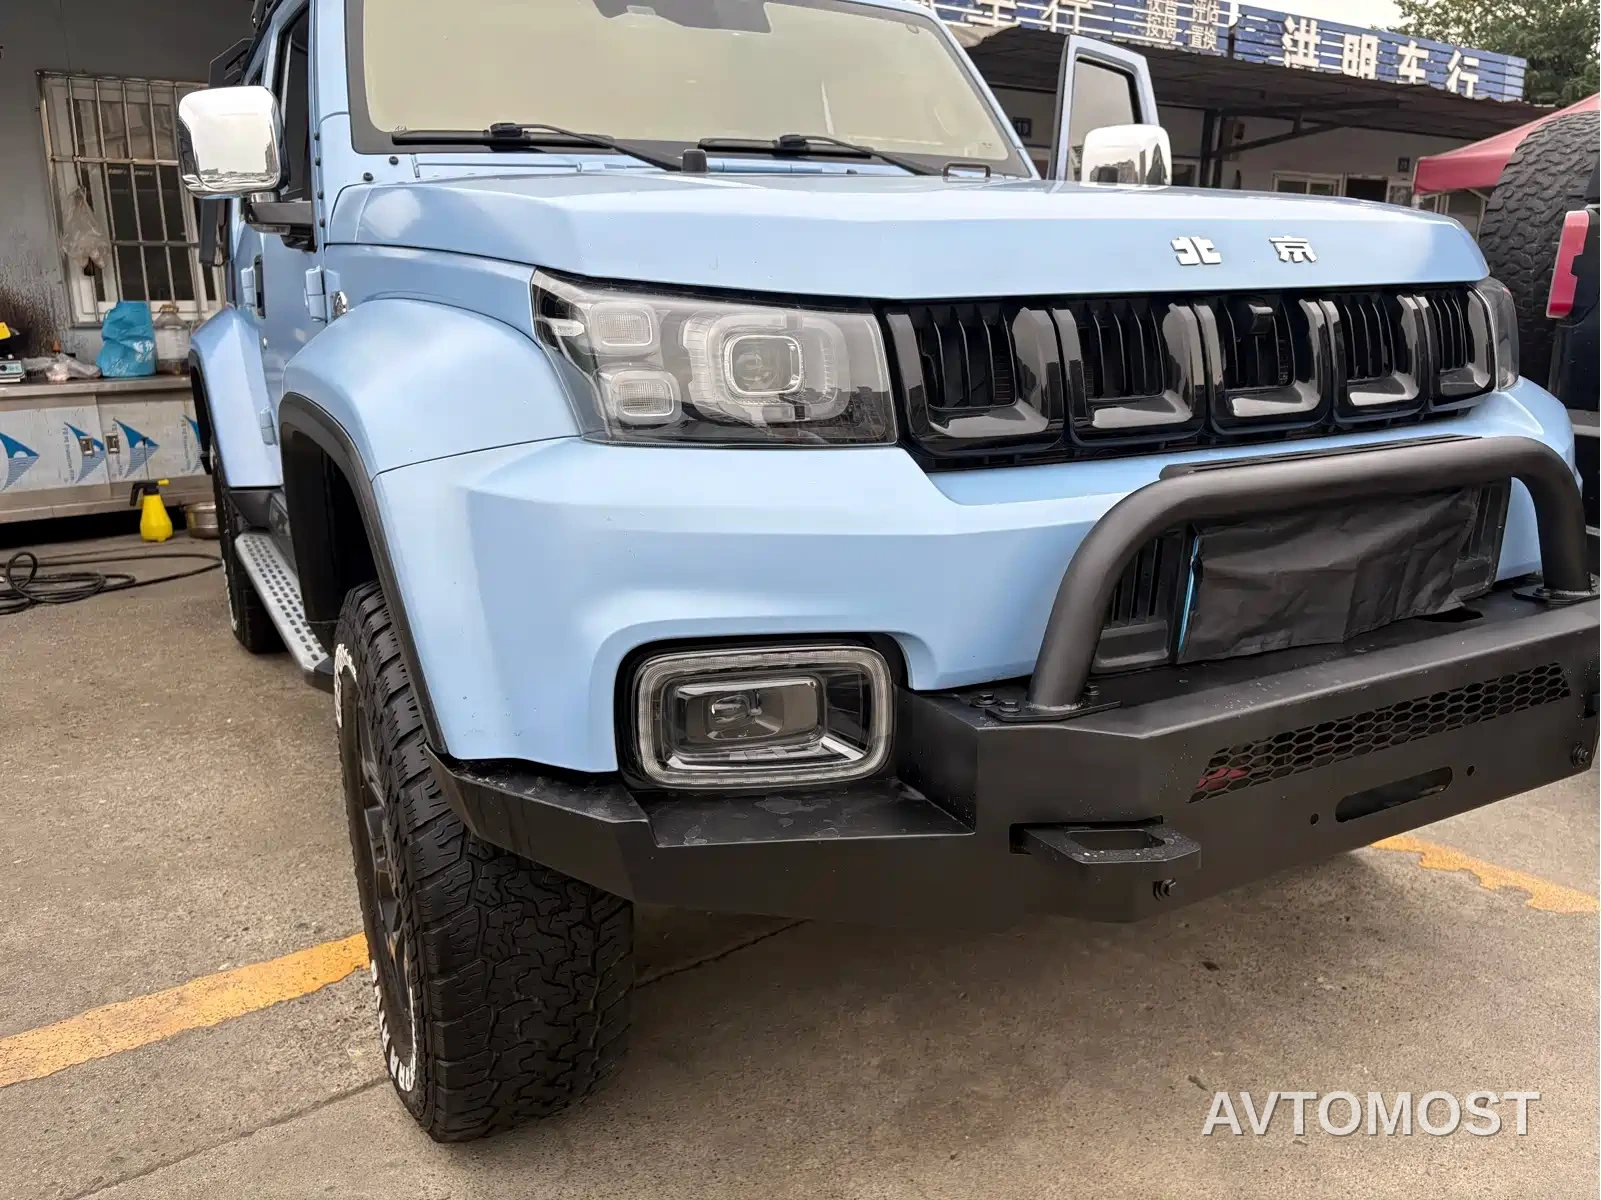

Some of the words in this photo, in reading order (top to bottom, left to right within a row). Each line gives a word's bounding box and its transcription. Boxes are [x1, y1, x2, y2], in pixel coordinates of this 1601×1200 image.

[1189, 25, 1217, 51] 置换
[1281, 15, 1480, 98] 洪明车行
[1170, 235, 1318, 265] 北京
